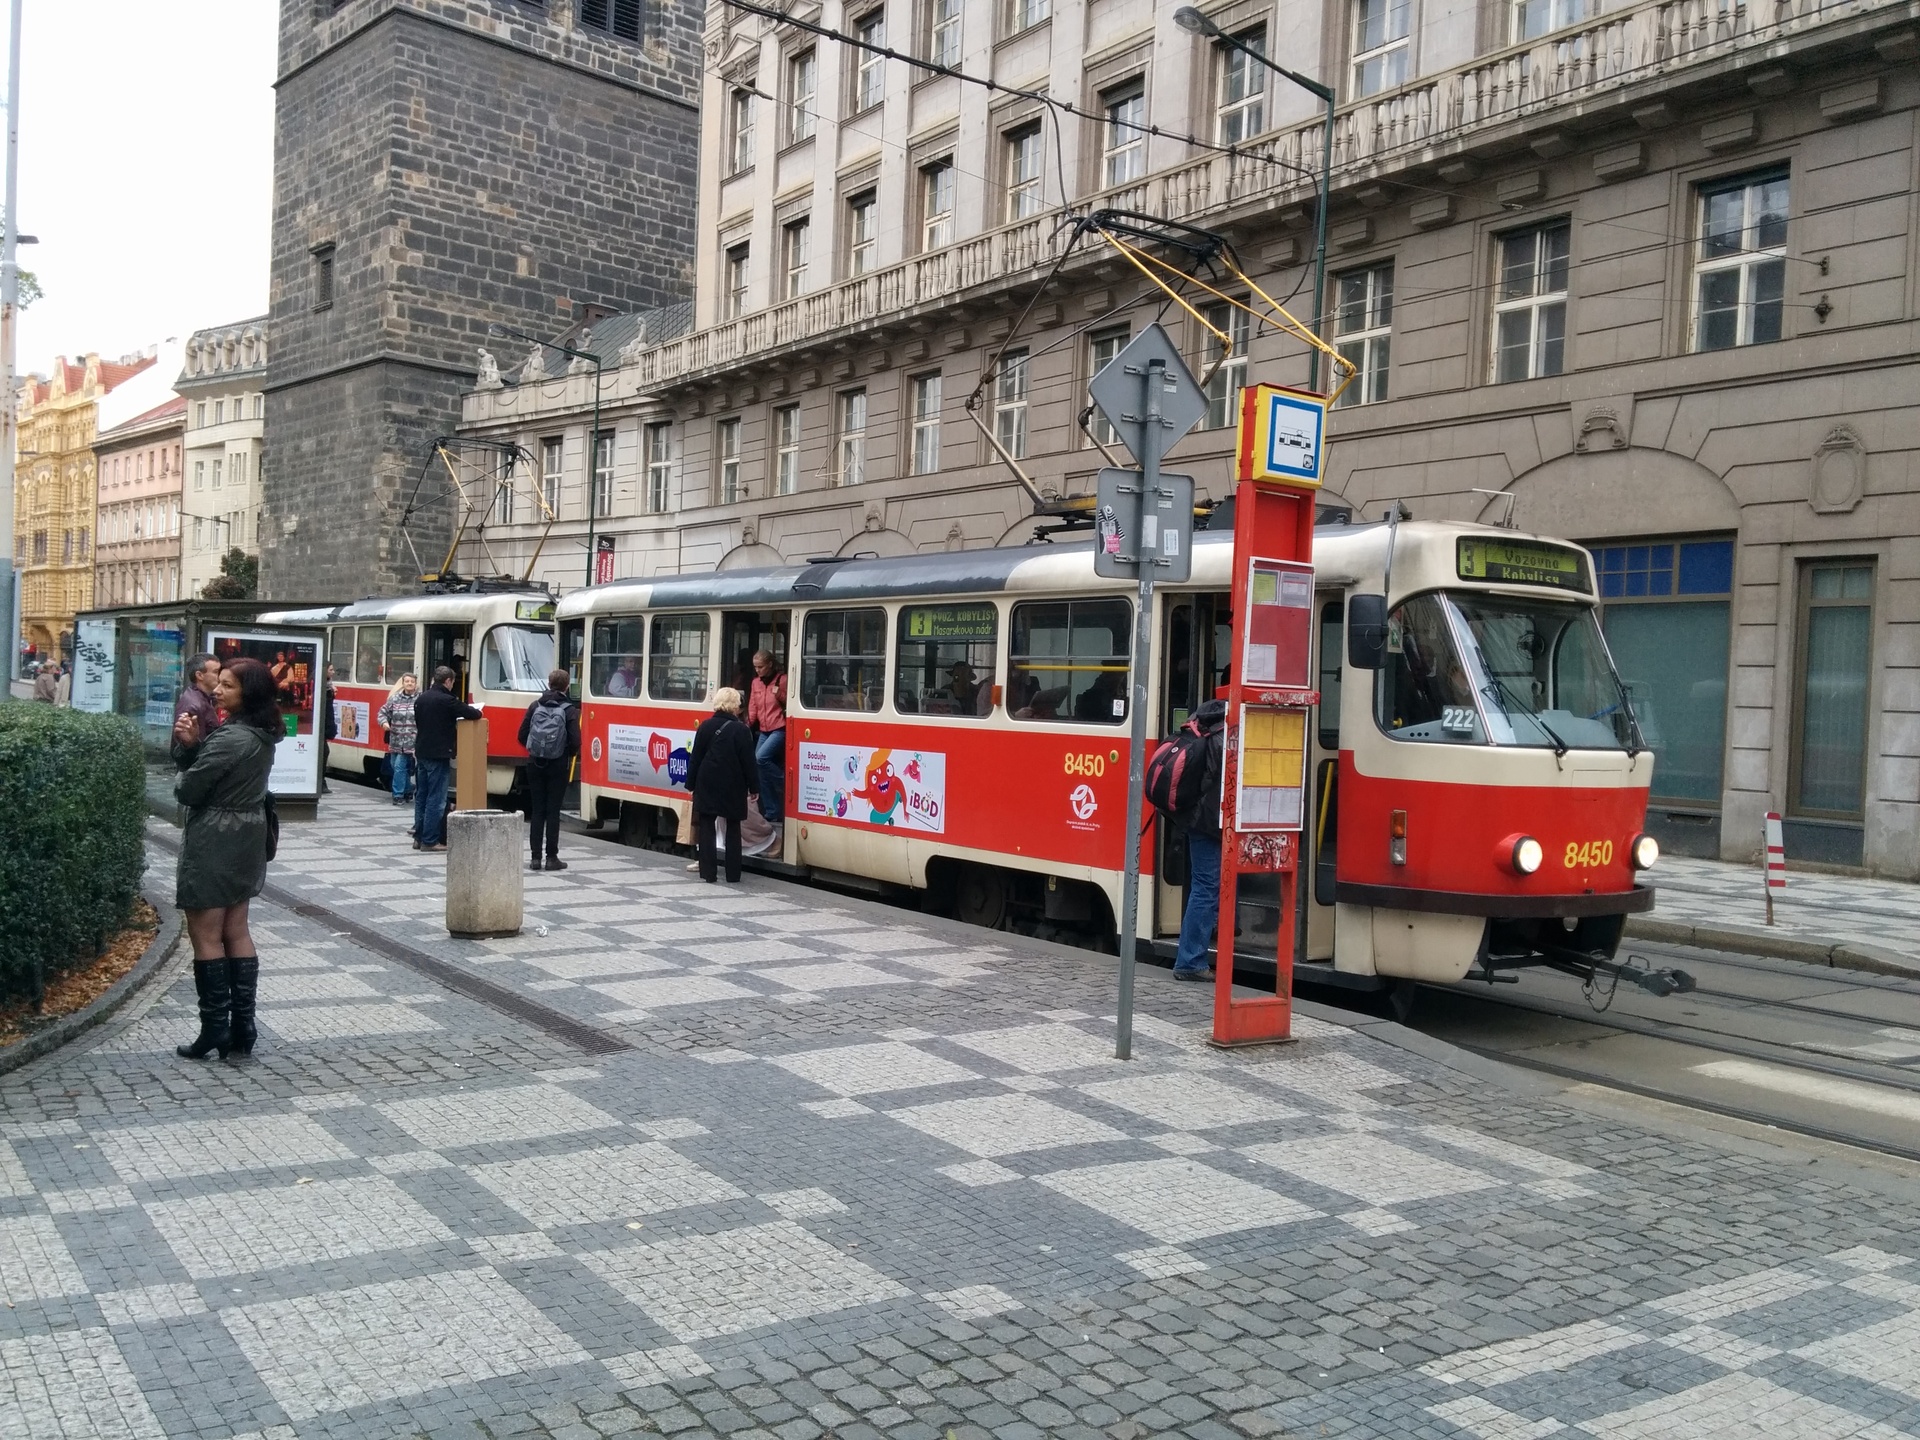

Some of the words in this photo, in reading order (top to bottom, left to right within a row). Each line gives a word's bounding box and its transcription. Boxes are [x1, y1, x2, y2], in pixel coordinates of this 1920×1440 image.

[1464, 544, 1475, 574] 3
[1504, 549, 1560, 569] Vozovna
[917, 612, 925, 635] 3
[957, 609, 997, 622] KOBYLISY
[1442, 708, 1475, 728] 222
[652, 740, 668, 760] VÍDEŇ
[807, 751, 827, 762] Bodujte
[669, 757, 688, 776] PRAHA
[810, 762, 831, 772] každém
[1064, 752, 1105, 778] 8450
[809, 773, 825, 783] kroku
[909, 790, 939, 818] iBOD
[1563, 839, 1613, 869] 8450
